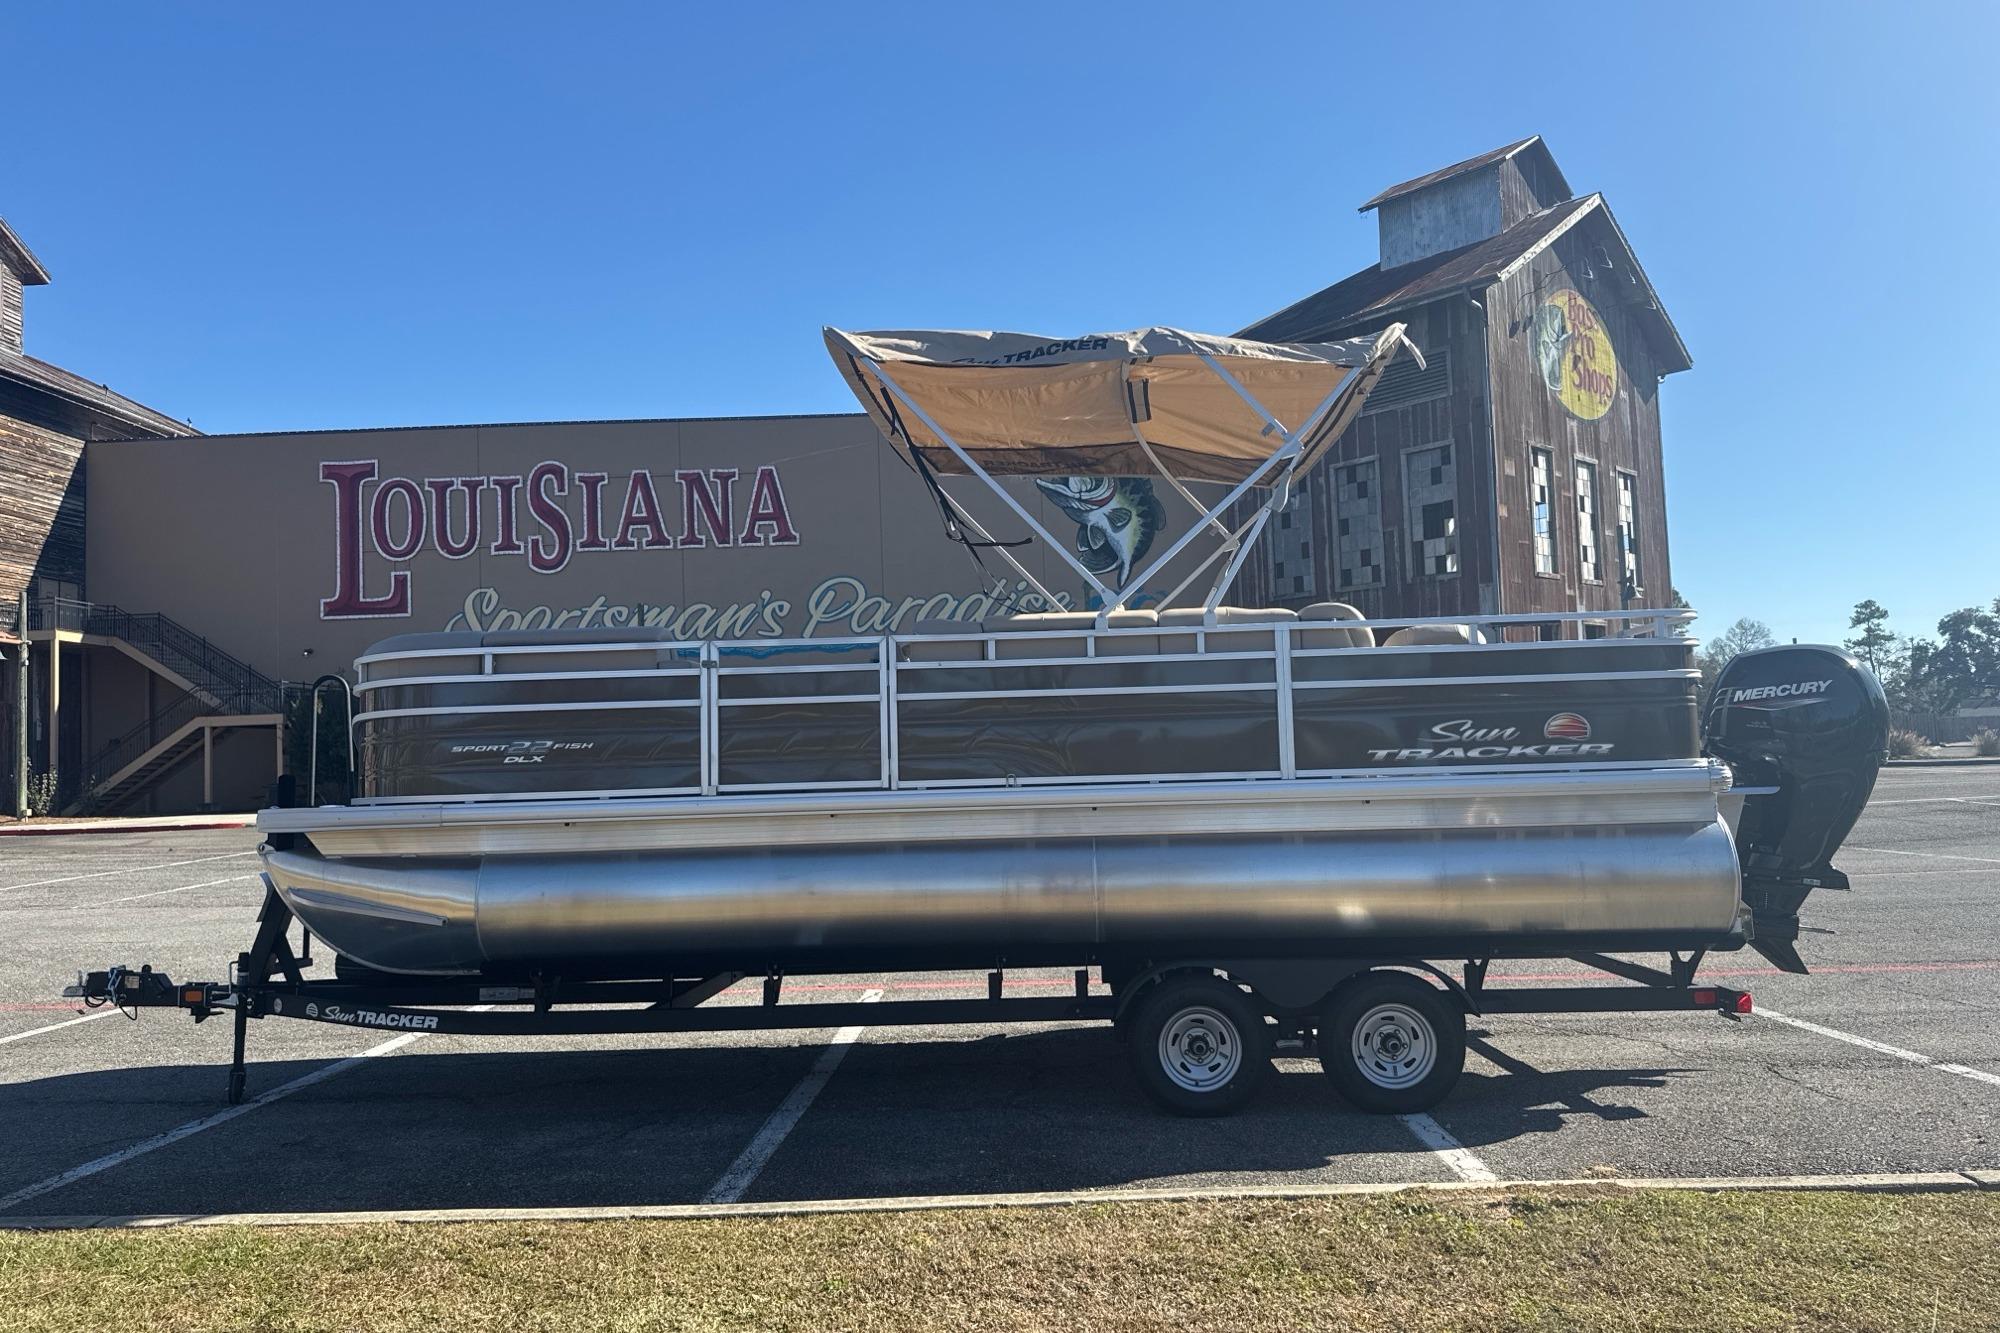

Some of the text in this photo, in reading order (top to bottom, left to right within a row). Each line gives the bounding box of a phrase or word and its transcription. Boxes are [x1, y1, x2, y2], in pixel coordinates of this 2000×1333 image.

[1003, 337, 1109, 364] TRACKER
[1572, 355, 1614, 404] Shops
[319, 459, 800, 620] LOUISIANA
[1733, 680, 1833, 702] MERCURY
[1418, 719, 1521, 742] Sun
[451, 740, 594, 754] SPORT 22 FISH
[1367, 743, 1615, 761] TRACKER
[503, 755, 545, 764] DLX
[321, 1005, 439, 1029] Sun TRACKER
